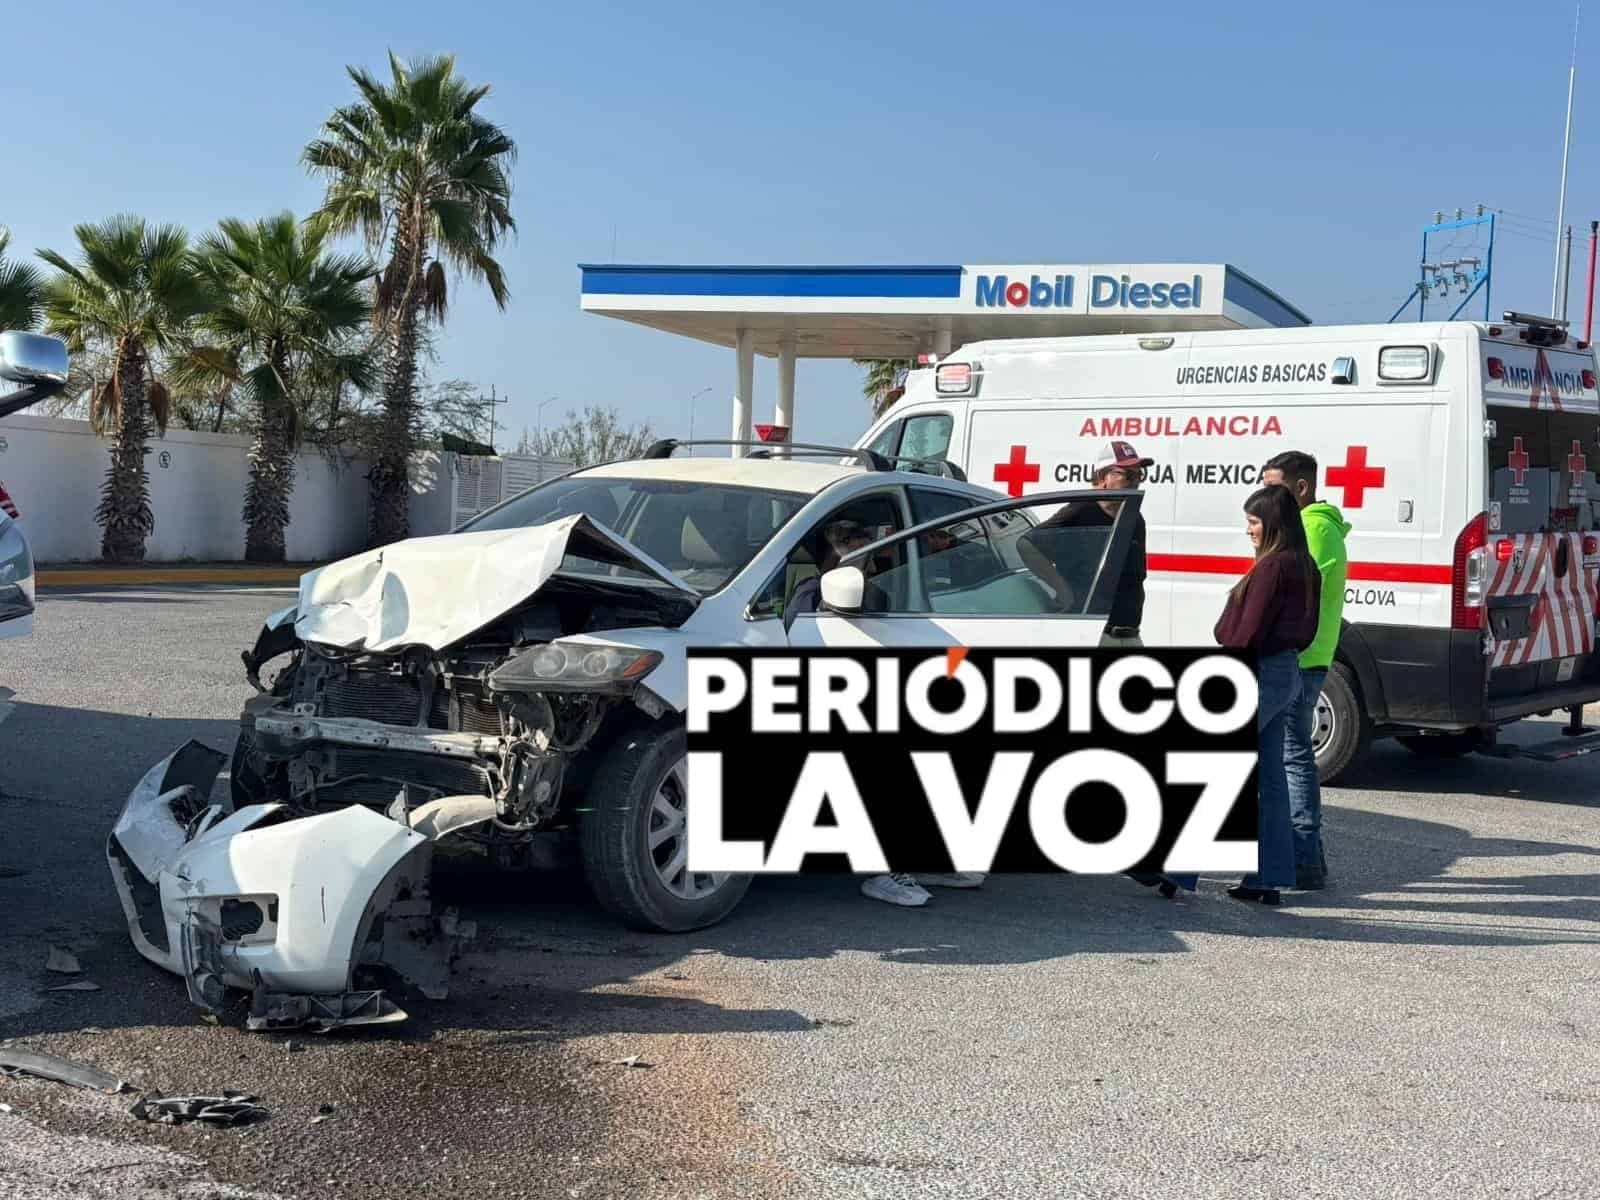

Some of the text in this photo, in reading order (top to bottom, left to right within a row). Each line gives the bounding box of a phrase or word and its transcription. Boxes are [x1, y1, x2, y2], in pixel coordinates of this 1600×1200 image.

[976, 275, 1074, 307] Mobil
[1091, 275, 1201, 308] Diesel
[1176, 363, 1327, 385] URGENCIAS BASICAS
[1079, 416, 1282, 437] AMBULANCIA
[1055, 463, 1265, 485] CRU OJA MEXICA
[1343, 588, 1396, 607] CLOVA
